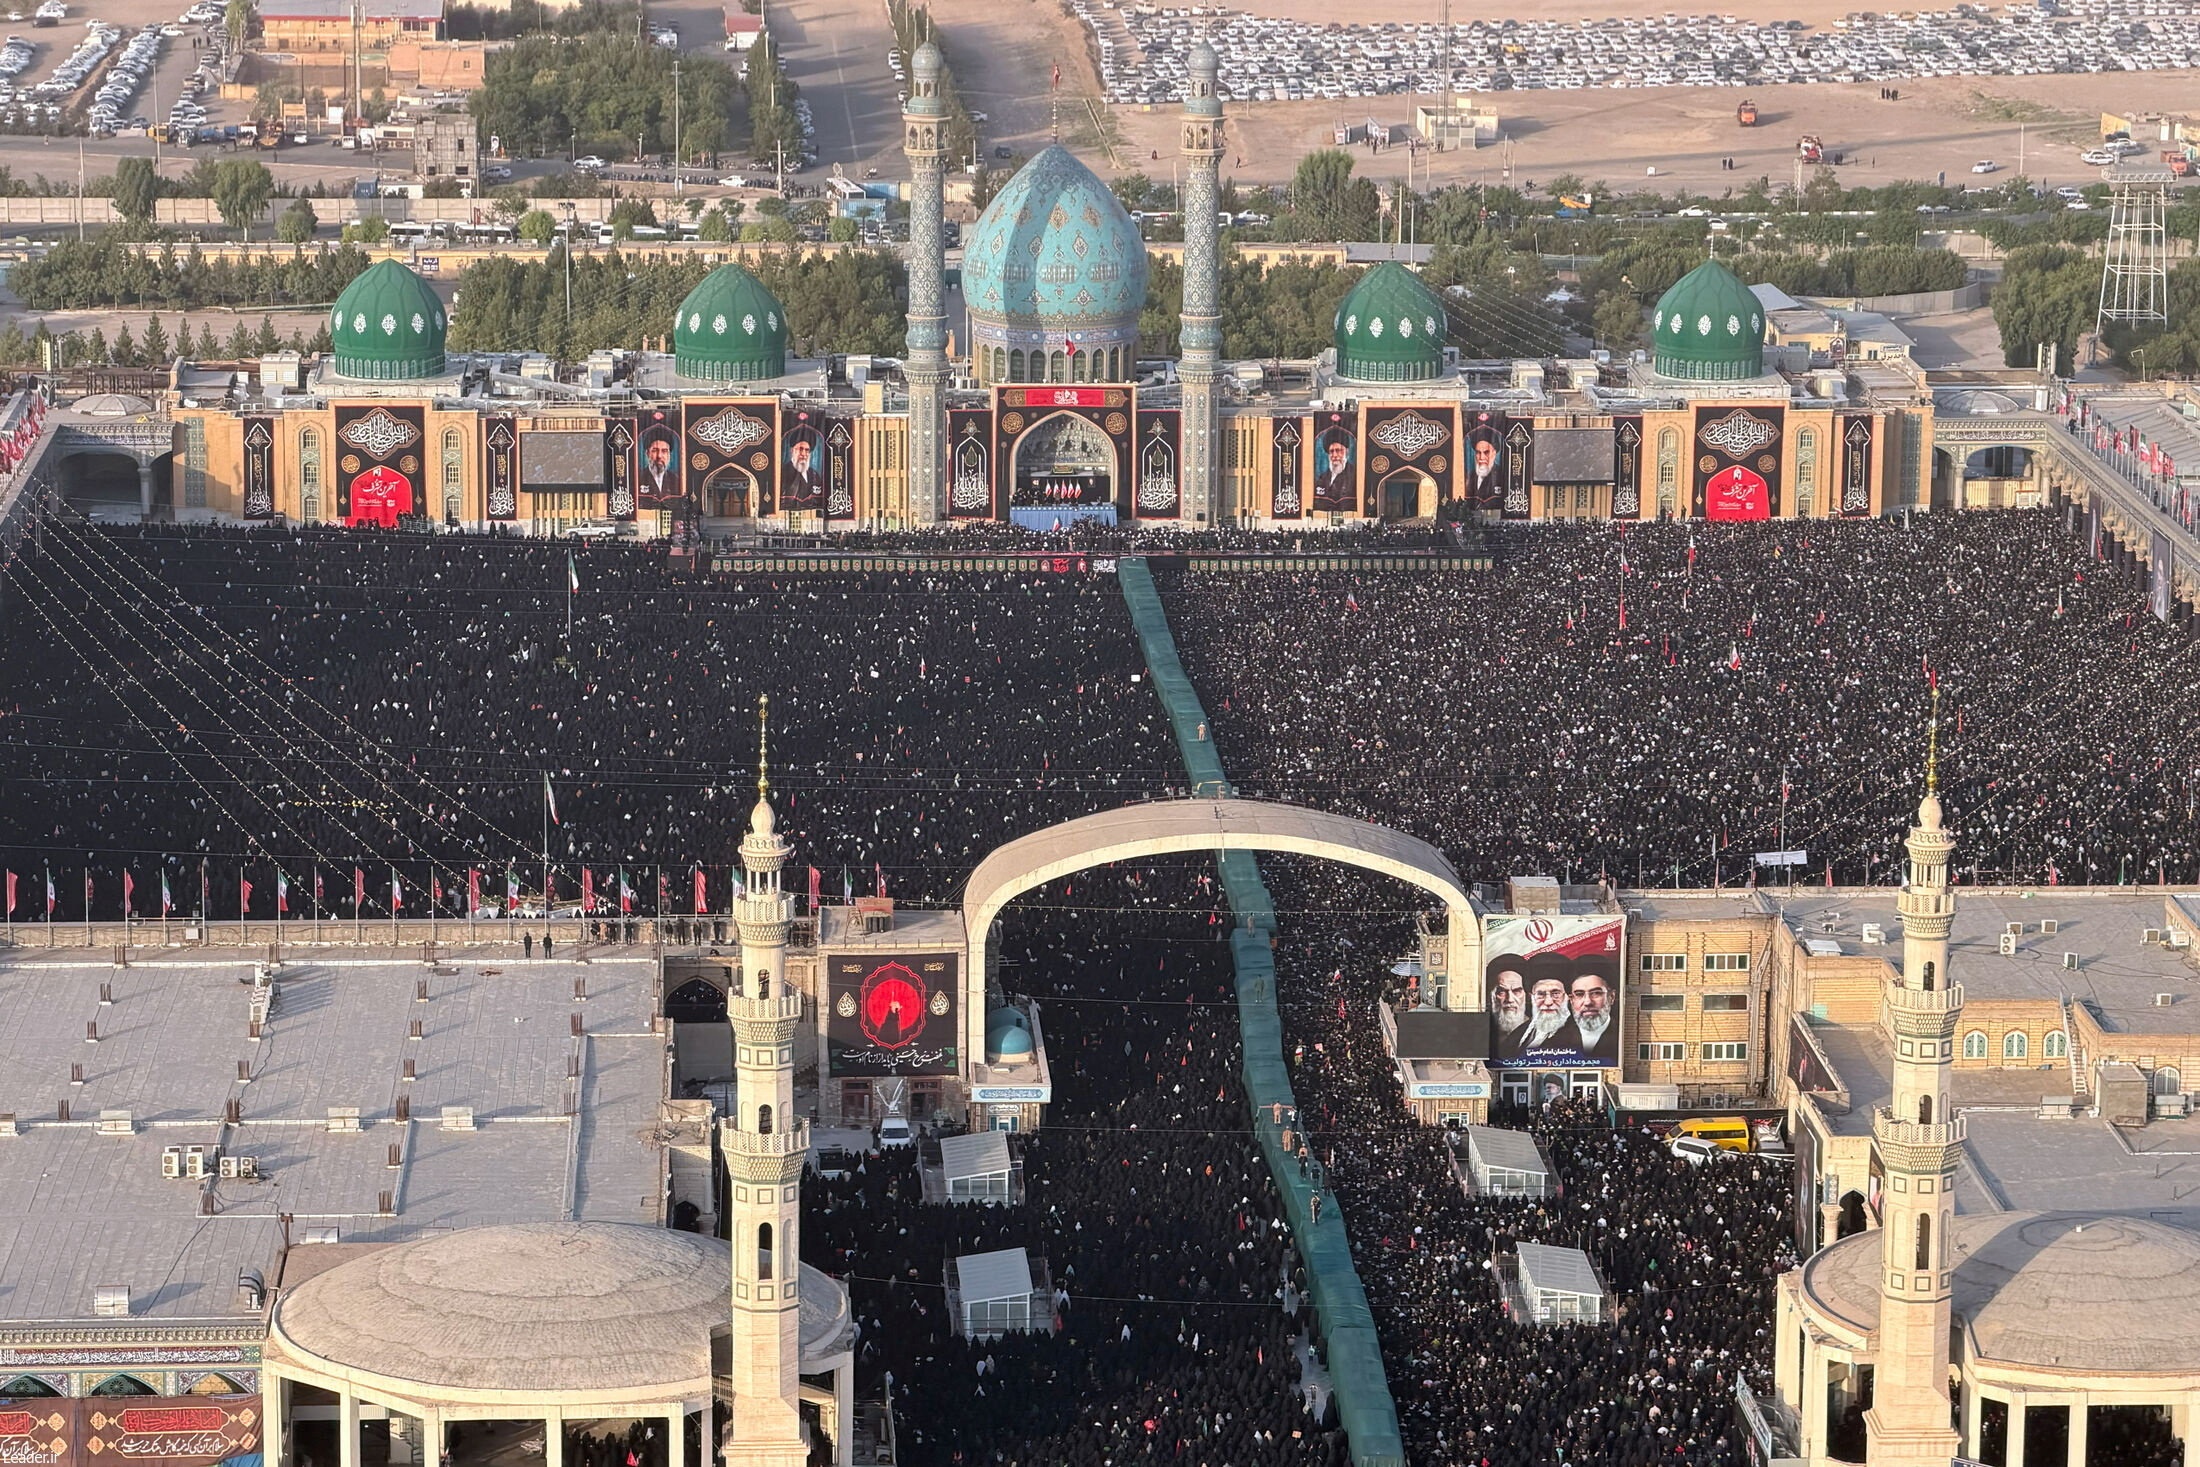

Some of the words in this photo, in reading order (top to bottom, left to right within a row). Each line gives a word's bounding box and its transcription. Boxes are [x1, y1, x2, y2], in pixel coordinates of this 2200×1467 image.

[376, 480, 400, 498] آخرین
[1736, 483, 1759, 501] آخرین
[1543, 1048, 1554, 1056] امام
[1527, 1058, 1546, 1066] دفتر
[1552, 1058, 1572, 1066] اداری
[185, 1433, 198, 1451] که
[197, 1438, 212, 1453] آن
[212, 1438, 224, 1454] سلام
